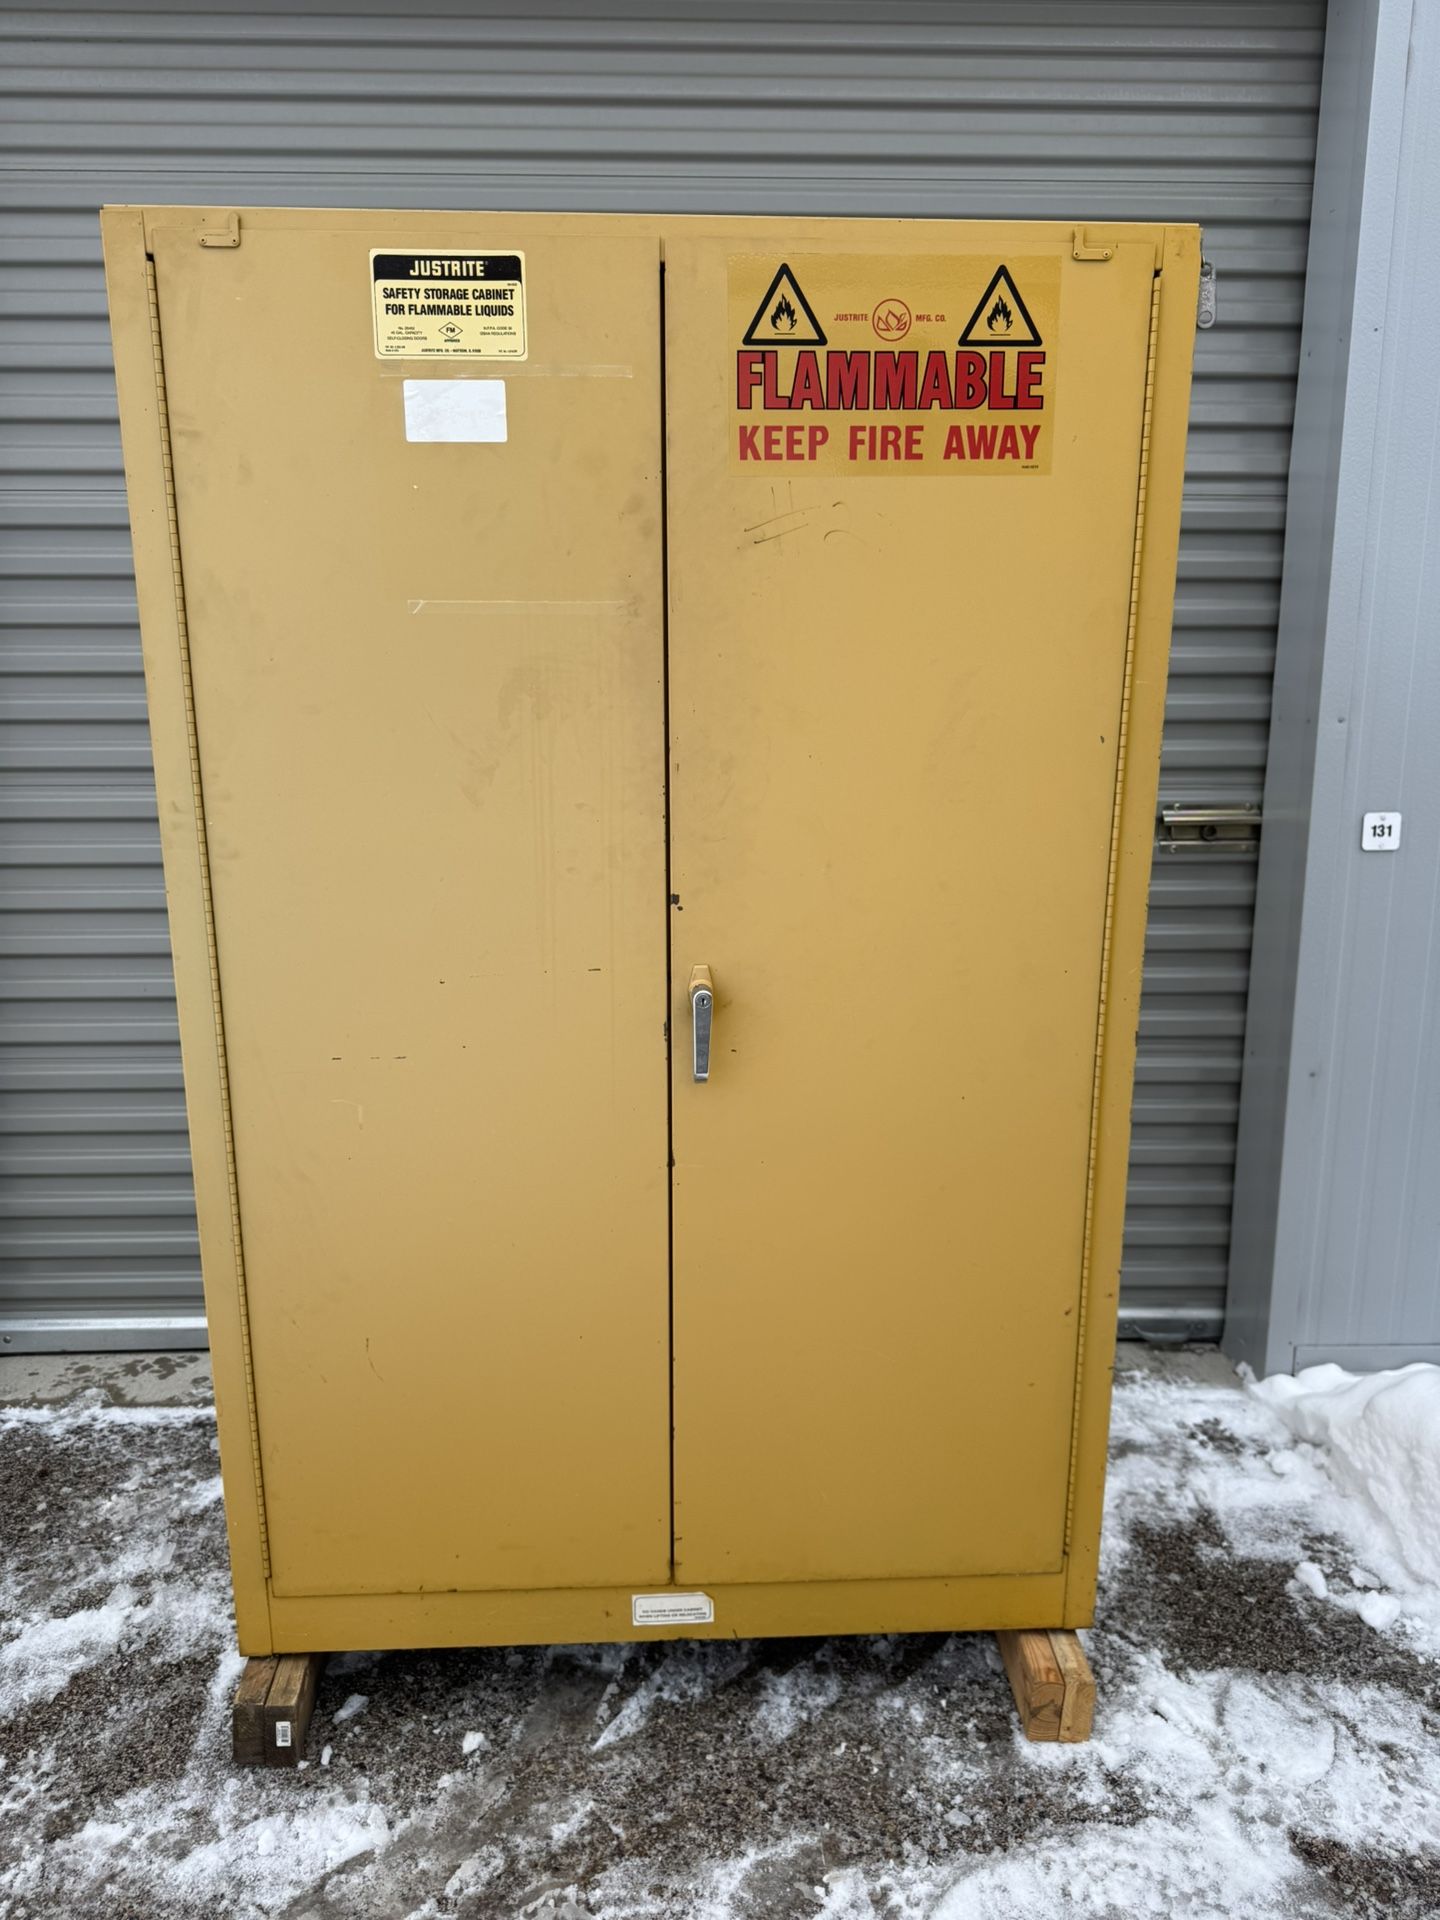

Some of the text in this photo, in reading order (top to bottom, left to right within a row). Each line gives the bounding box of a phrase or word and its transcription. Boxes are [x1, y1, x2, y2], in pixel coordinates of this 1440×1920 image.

[410, 260, 485, 277] JUSTRITE
[382, 287, 515, 301] SAFETY STORAGE CABINET
[385, 303, 514, 318] FOR FLAMMABLE LIQUIDS
[834, 313, 947, 323] JUSTRITE MFG. CO.
[446, 326, 456, 334] FM
[737, 350, 1046, 410] FLAMMABLE
[738, 425, 1041, 461] KEEP FIRE AWAY
[1371, 824, 1392, 838] 131
